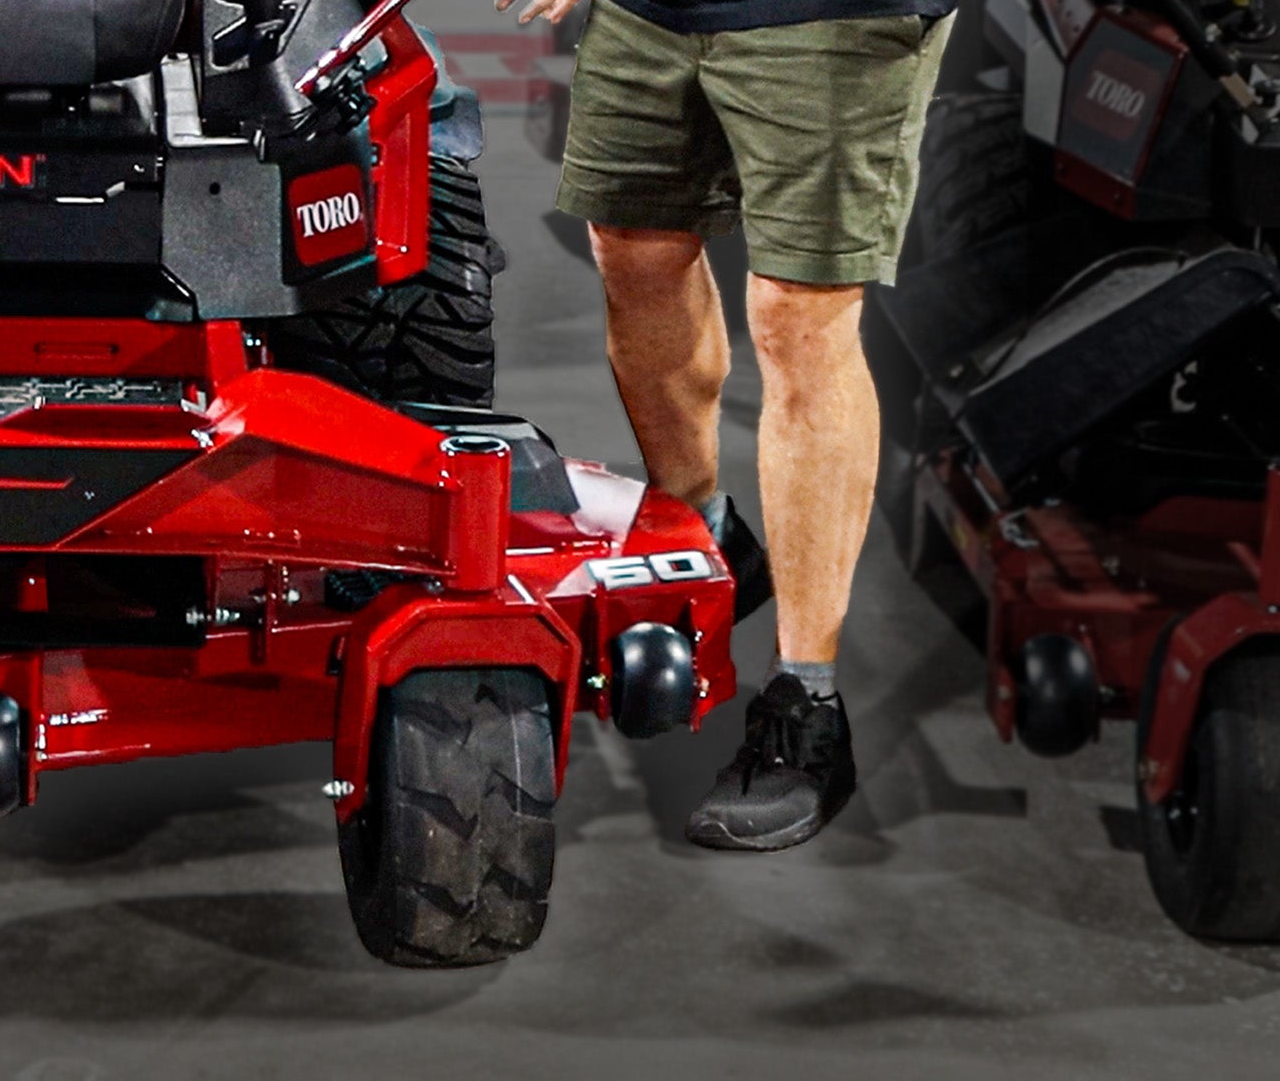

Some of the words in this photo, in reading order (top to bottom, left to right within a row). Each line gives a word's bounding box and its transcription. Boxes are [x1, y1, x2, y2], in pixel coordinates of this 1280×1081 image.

[1085, 71, 1146, 119] TORO
[296, 192, 361, 238] TORO
[587, 550, 713, 591] 60
